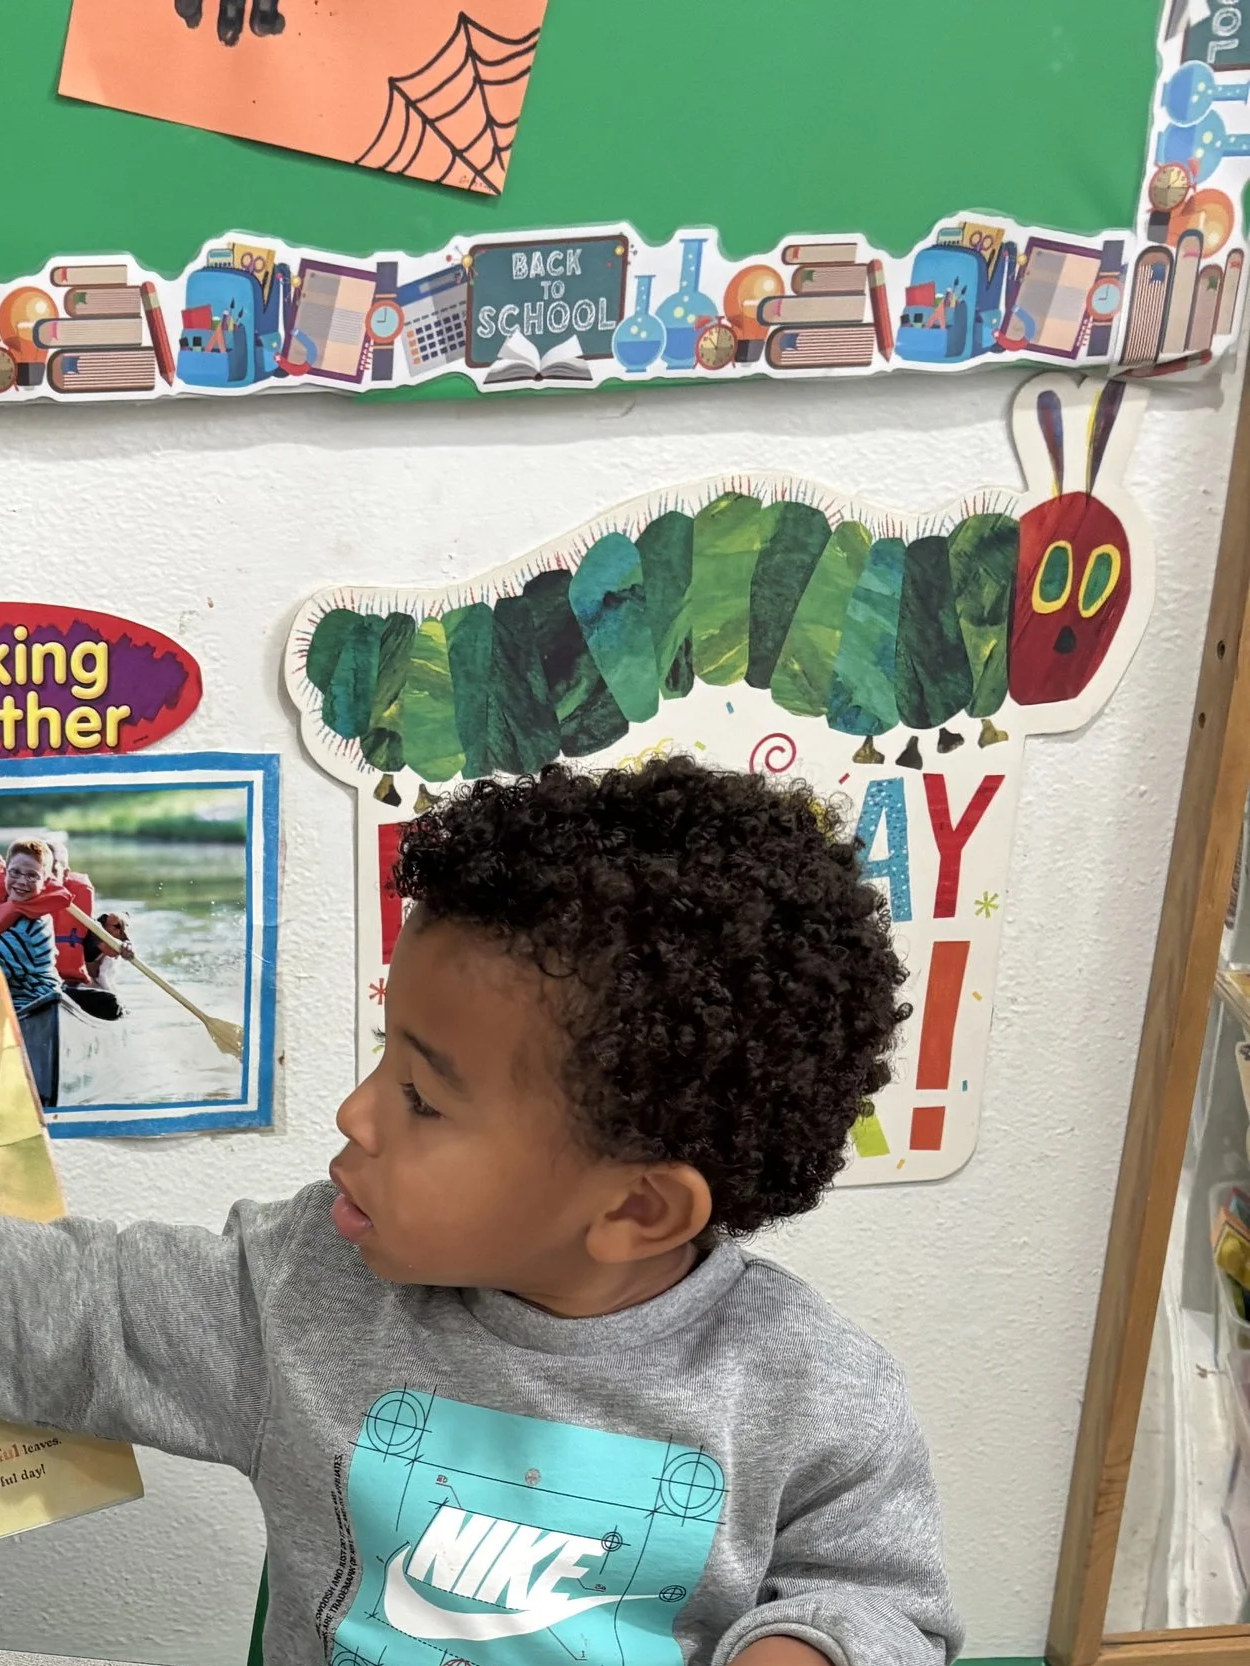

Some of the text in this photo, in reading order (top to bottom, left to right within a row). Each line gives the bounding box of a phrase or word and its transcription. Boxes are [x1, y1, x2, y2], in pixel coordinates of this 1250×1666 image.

[512, 249, 582, 280] BACK
[540, 280, 566, 300] TO
[476, 297, 616, 338] SCHOOL
[22, 1437, 62, 1455] leaves.
[21, 1463, 46, 1482] day!
[407, 1505, 608, 1610] NIKE
[331, 1569, 344, 1587] AND
[323, 1612, 333, 1631] ARE
[329, 1565, 357, 1613] TRADEMARK
